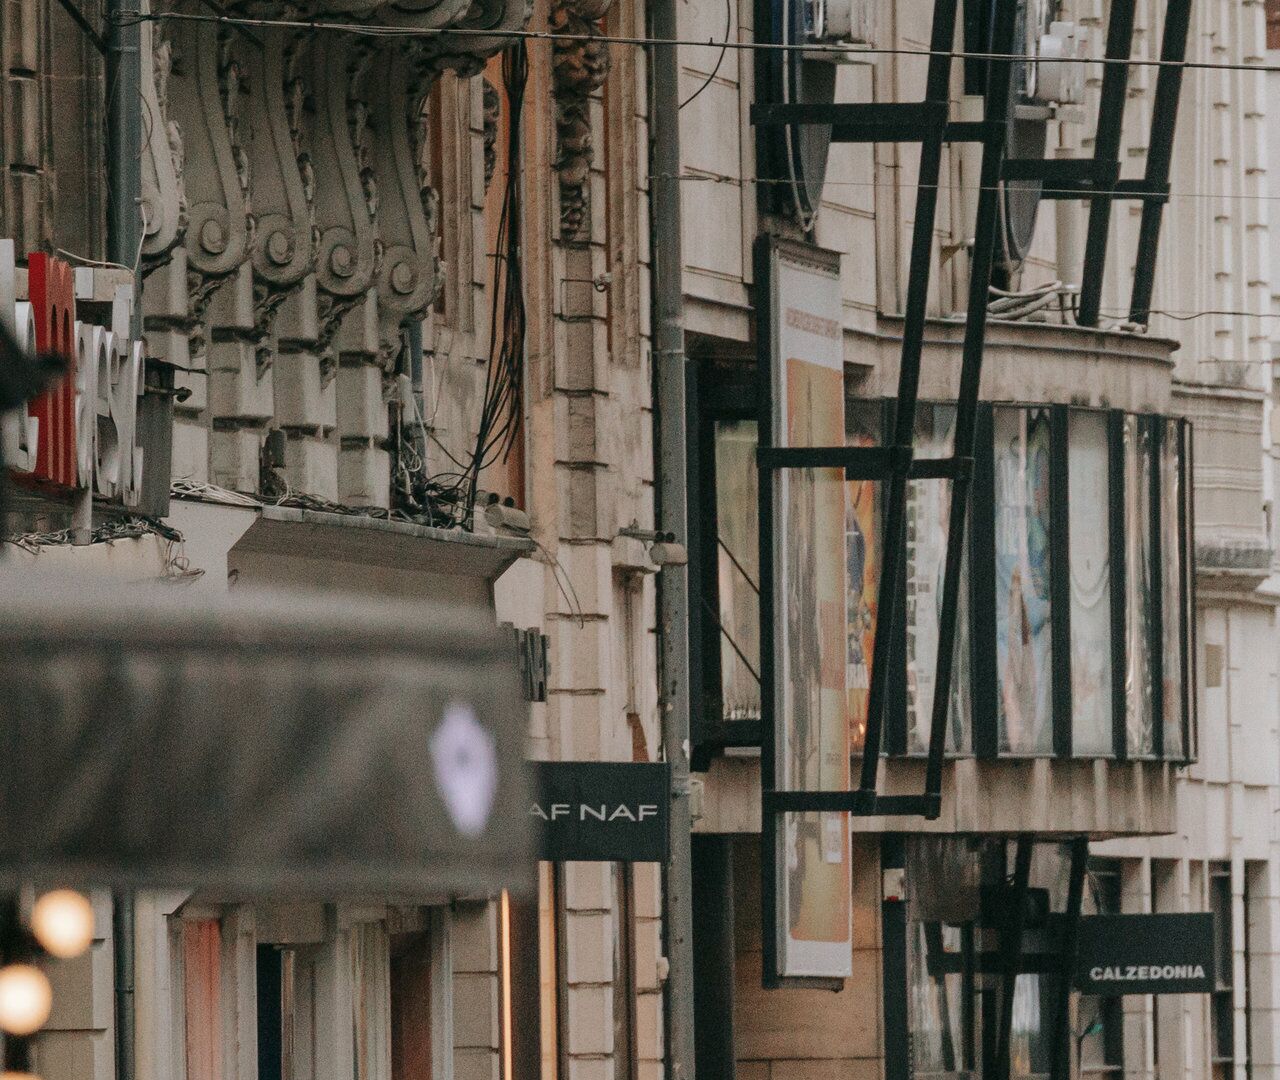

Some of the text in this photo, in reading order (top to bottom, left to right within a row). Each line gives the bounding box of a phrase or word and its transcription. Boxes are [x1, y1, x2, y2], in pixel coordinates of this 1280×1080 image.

[530, 803, 658, 822] AF NAF
[1089, 965, 1206, 981] CALZEDONIA
